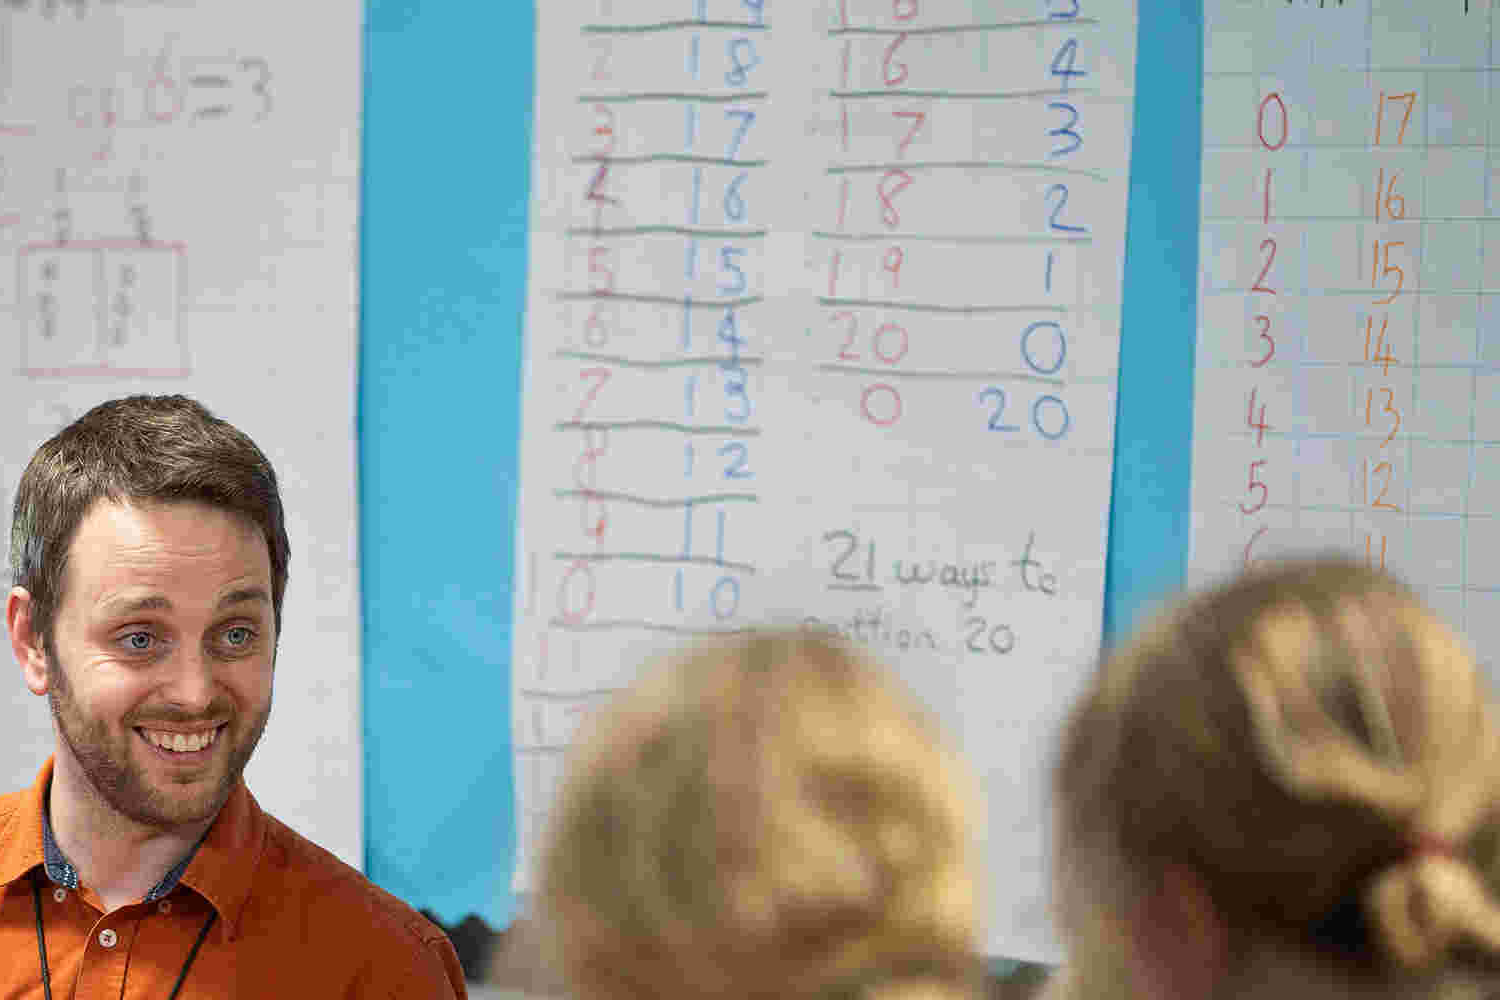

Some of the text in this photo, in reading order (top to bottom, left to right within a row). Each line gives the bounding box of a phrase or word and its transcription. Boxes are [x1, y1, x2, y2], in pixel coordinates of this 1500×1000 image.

[1050, 38, 1091, 96] 4
[1048, 102, 1083, 160] 3
[1257, 90, 1417, 151] 0 17
[1045, 183, 1090, 232] 2
[1262, 167, 1405, 225] 1 16
[1251, 238, 1405, 305] 2 15
[830, 311, 1069, 376] 20 0
[1251, 313, 1398, 377] 3 14
[859, 384, 1071, 442] 0 20
[1246, 386, 1401, 450] 4 13
[1237, 455, 1404, 515] 5 12
[822, 528, 1060, 610] 21 ways to
[966, 613, 1019, 656] 20
